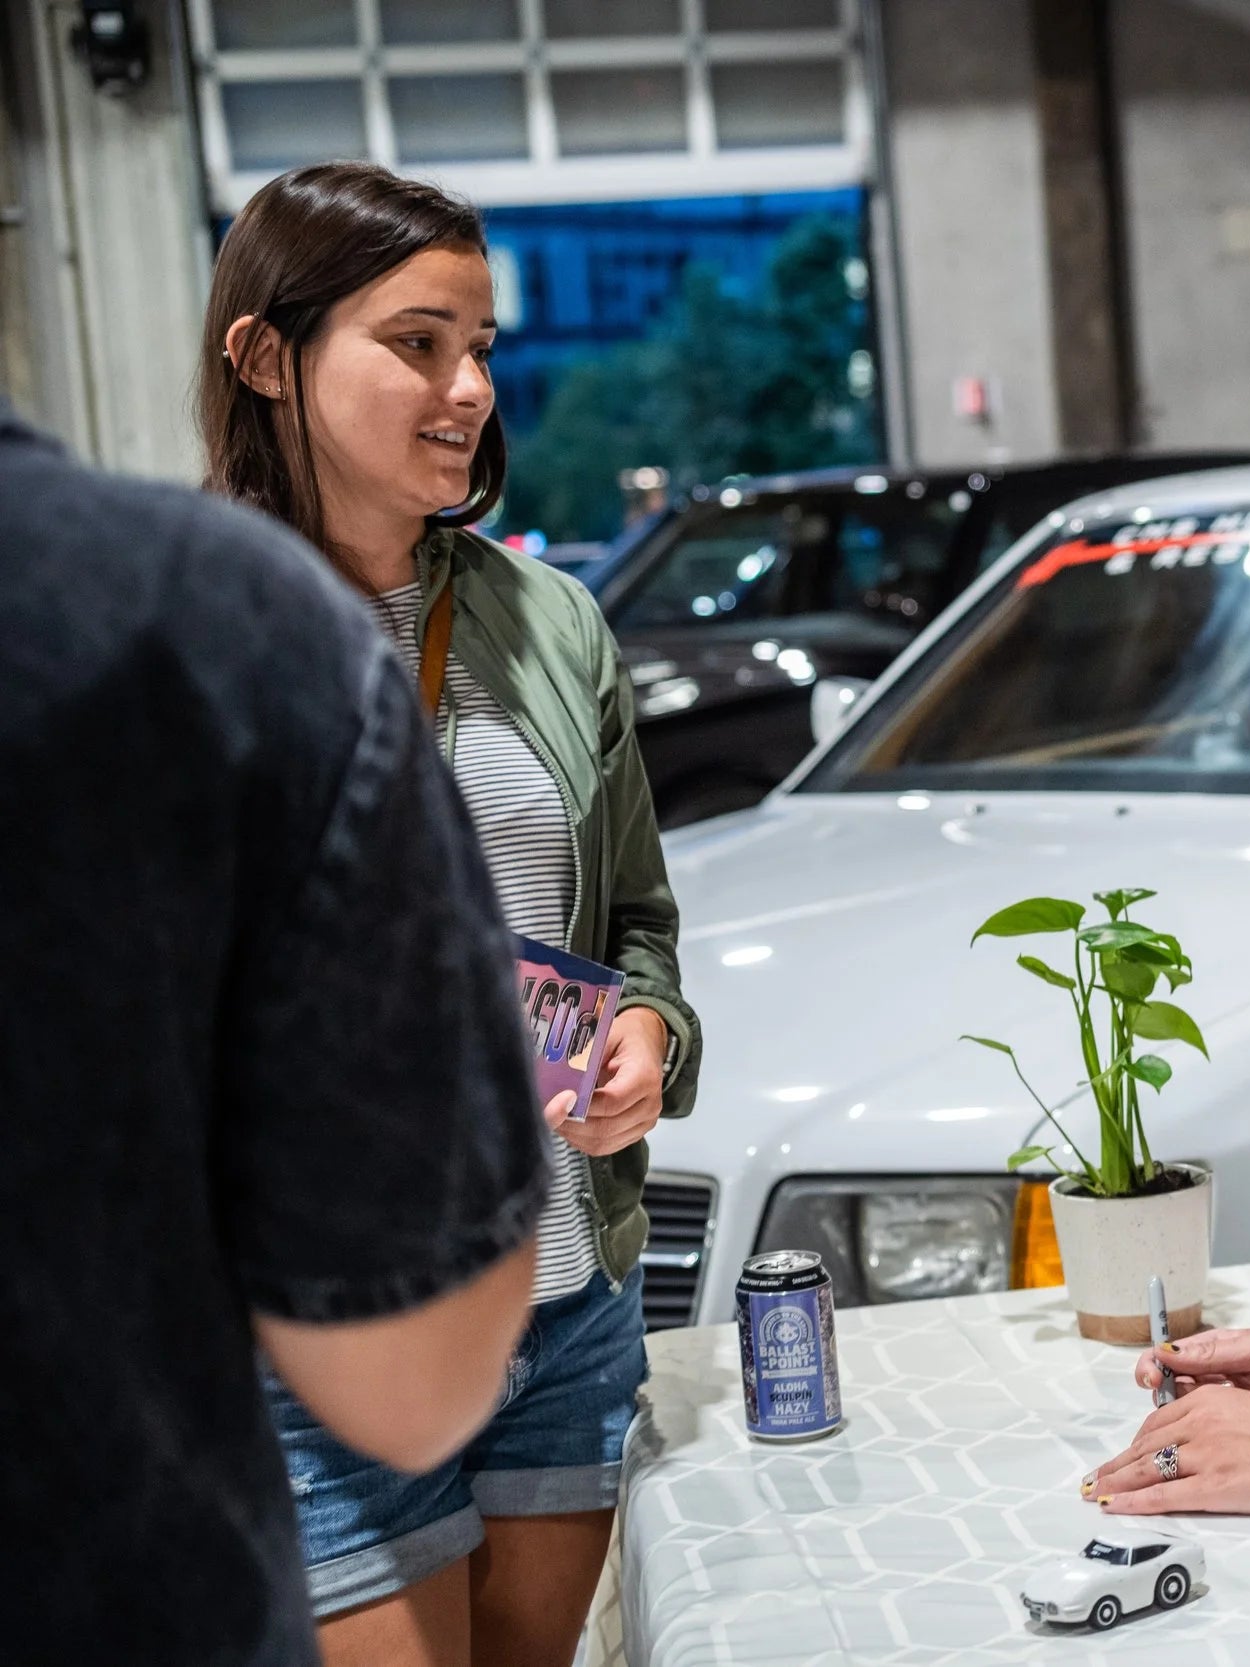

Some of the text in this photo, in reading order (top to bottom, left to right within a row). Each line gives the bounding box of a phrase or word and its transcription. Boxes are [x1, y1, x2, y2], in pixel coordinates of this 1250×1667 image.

[758, 1340, 816, 1358] BALLAST
[768, 1354, 810, 1369] POINT
[773, 1381, 808, 1394] ALOHA
[769, 1390, 813, 1402] SCULPIN
[775, 1401, 810, 1416] HAZY
[788, 1417, 804, 1425] PALE
[804, 1415, 816, 1424] ALE
